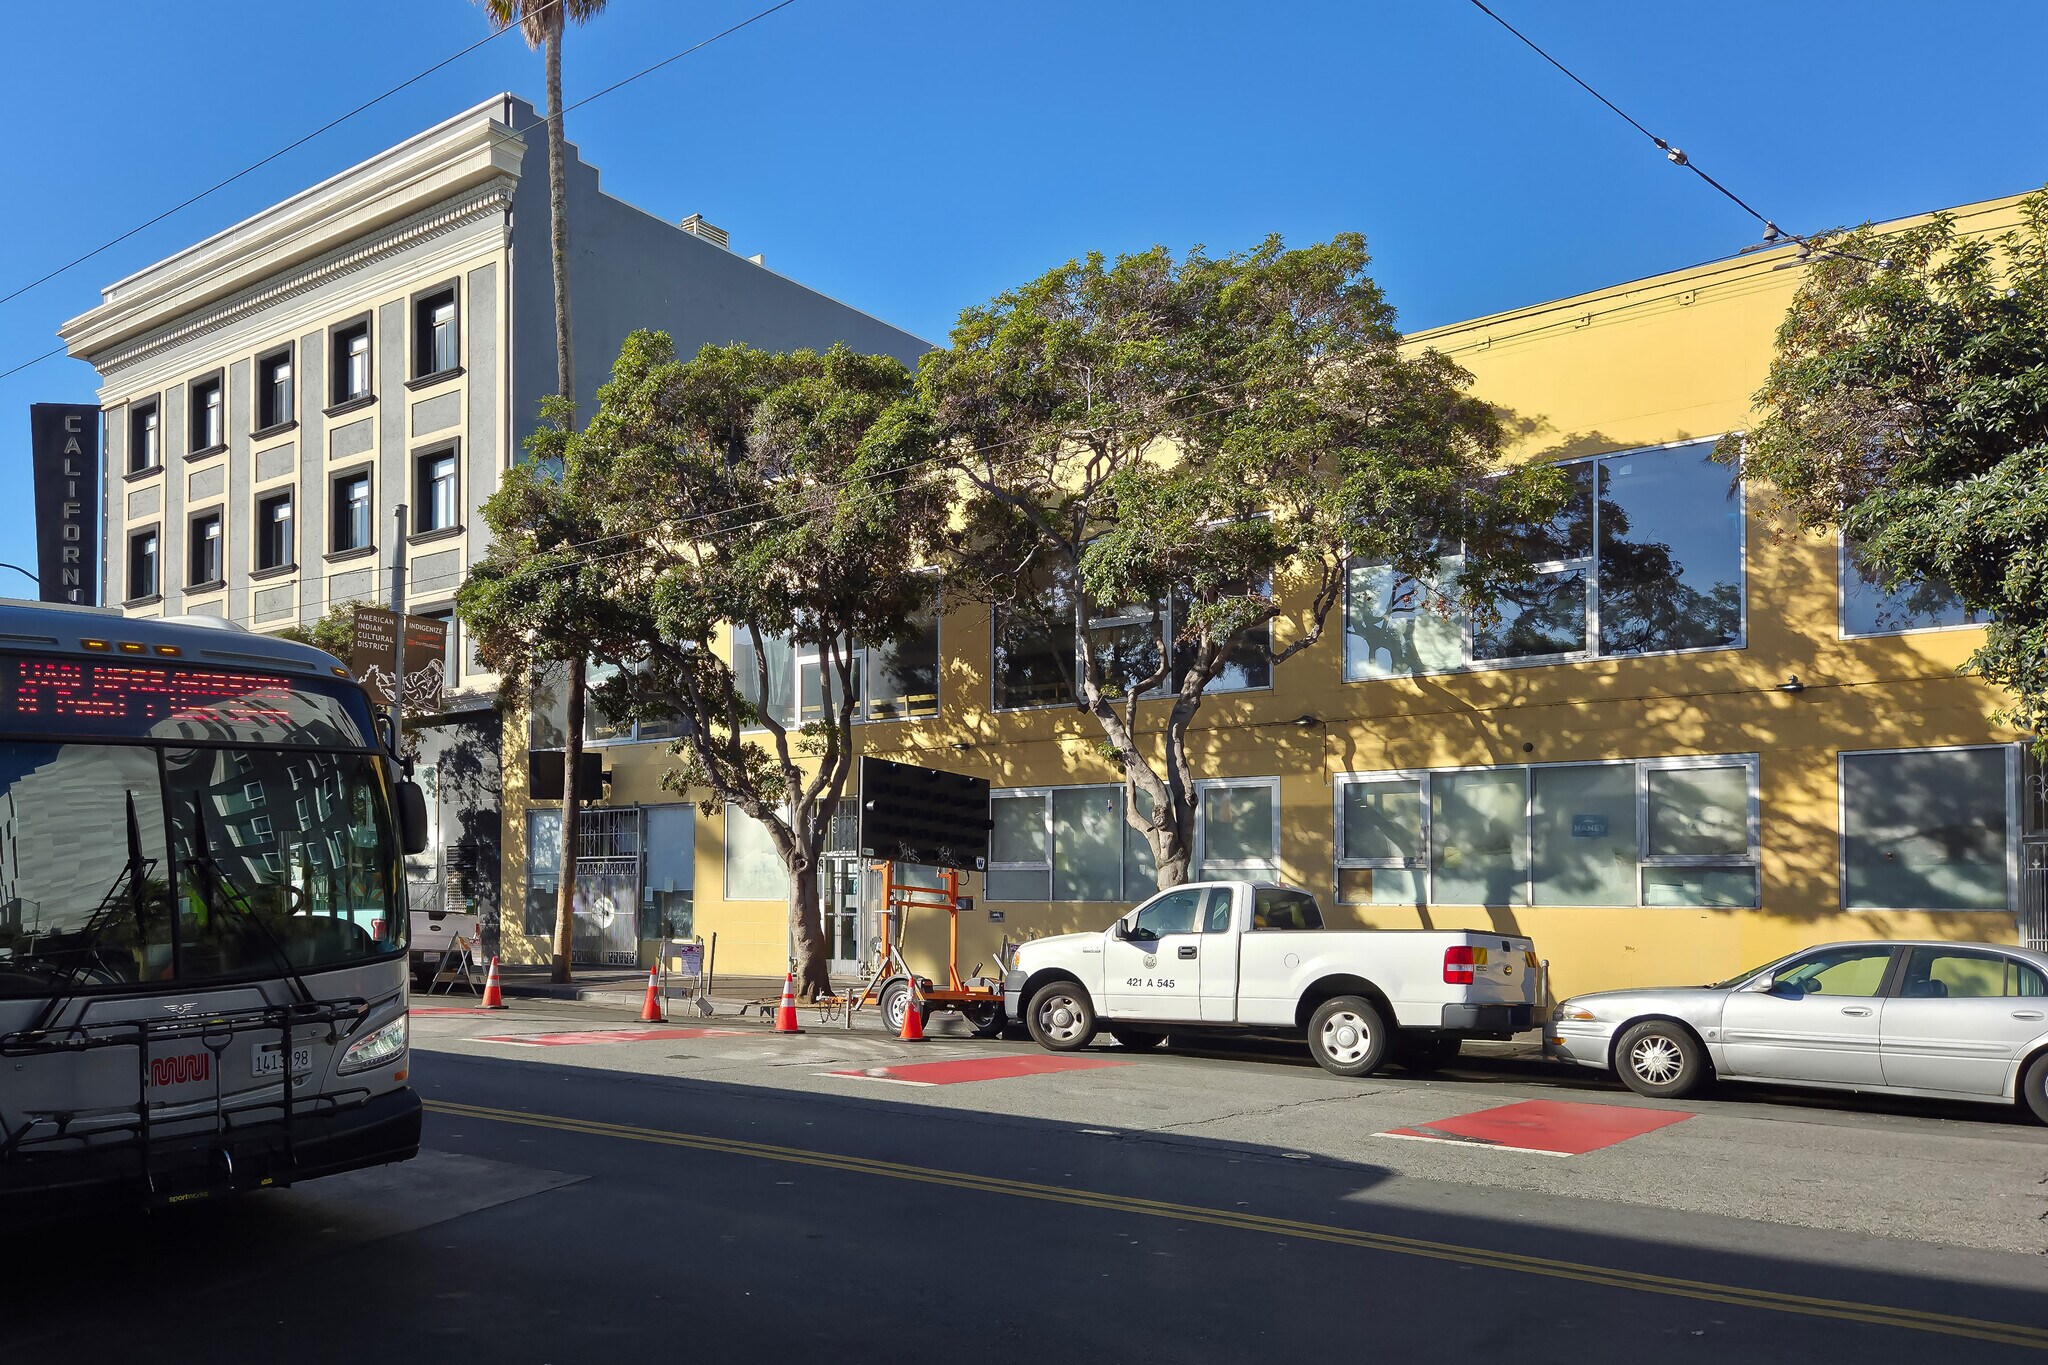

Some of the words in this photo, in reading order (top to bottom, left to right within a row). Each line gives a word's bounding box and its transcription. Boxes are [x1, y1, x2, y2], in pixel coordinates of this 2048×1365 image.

[358, 614, 394, 625] AMERICAN
[357, 622, 383, 632] INDIAN
[408, 622, 443, 634] INDIGENIZE
[357, 631, 394, 644] CULTURAL
[357, 640, 389, 651] DISTRICT
[1126, 977, 1142, 987] 421
[1146, 978, 1154, 988] A
[1156, 978, 1175, 989] 545
